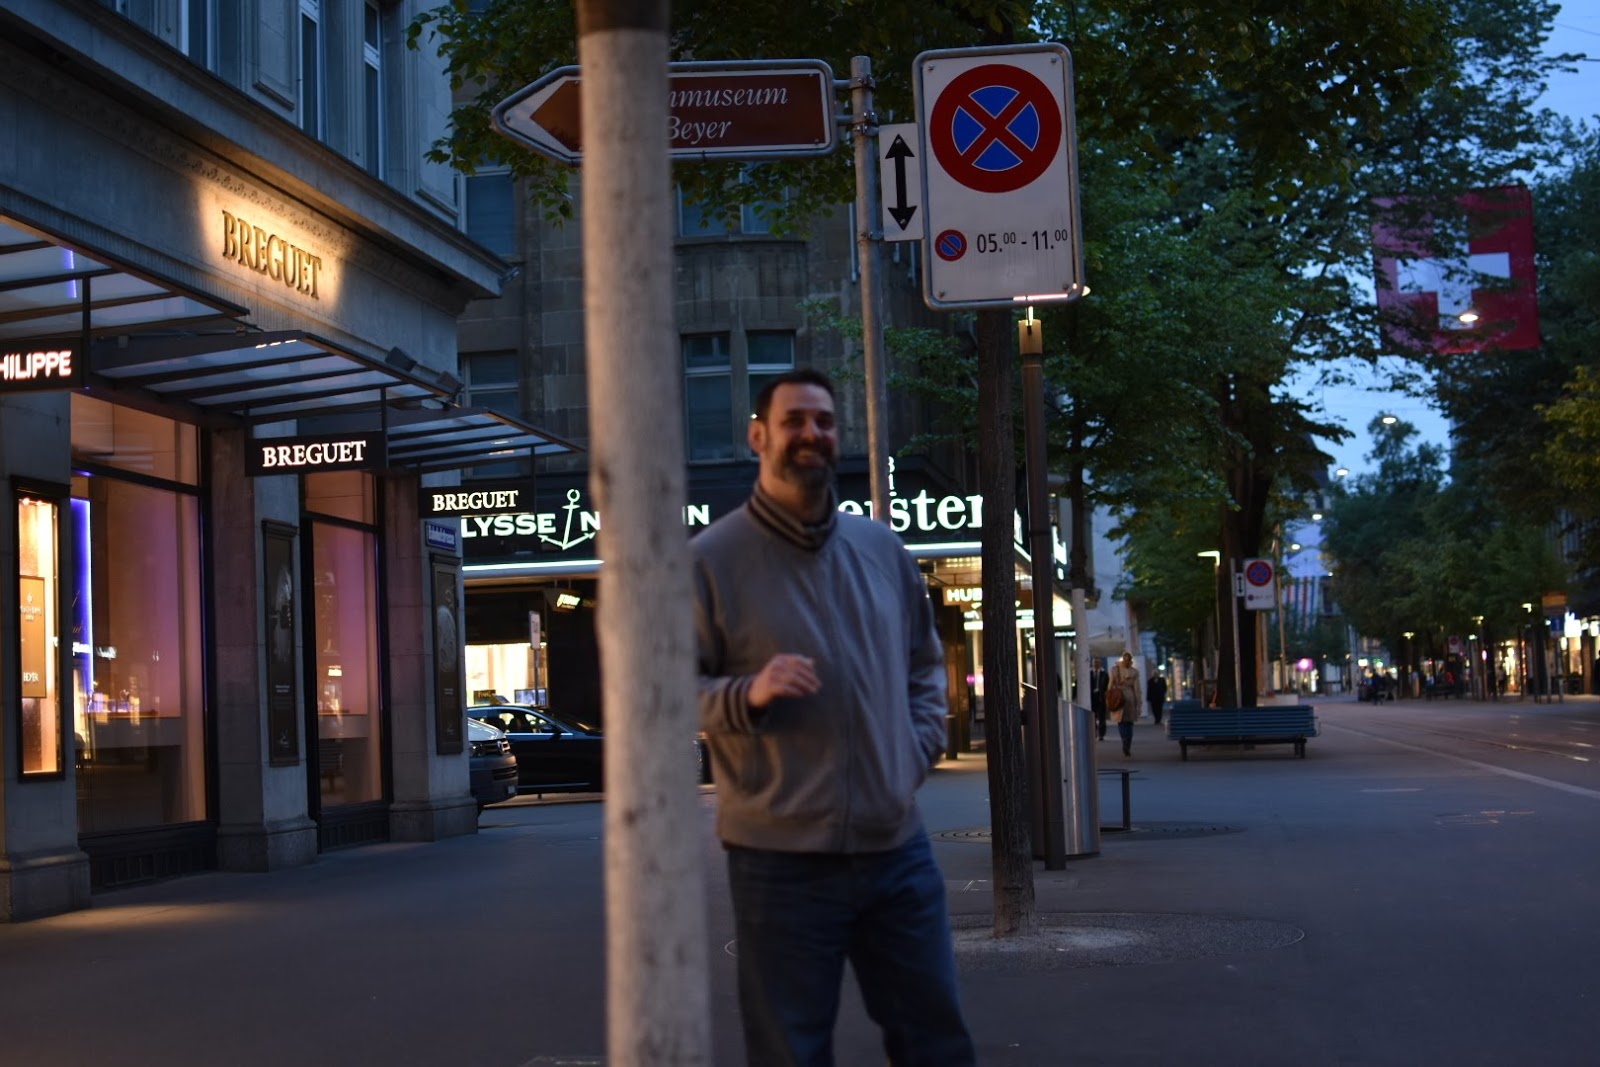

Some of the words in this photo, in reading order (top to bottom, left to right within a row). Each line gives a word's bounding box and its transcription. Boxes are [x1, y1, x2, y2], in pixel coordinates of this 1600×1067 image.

[668, 115, 732, 146] Beyer
[222, 210, 322, 301] BREGUET
[262, 440, 367, 468] BREGUET
[432, 489, 519, 511] BREGUET
